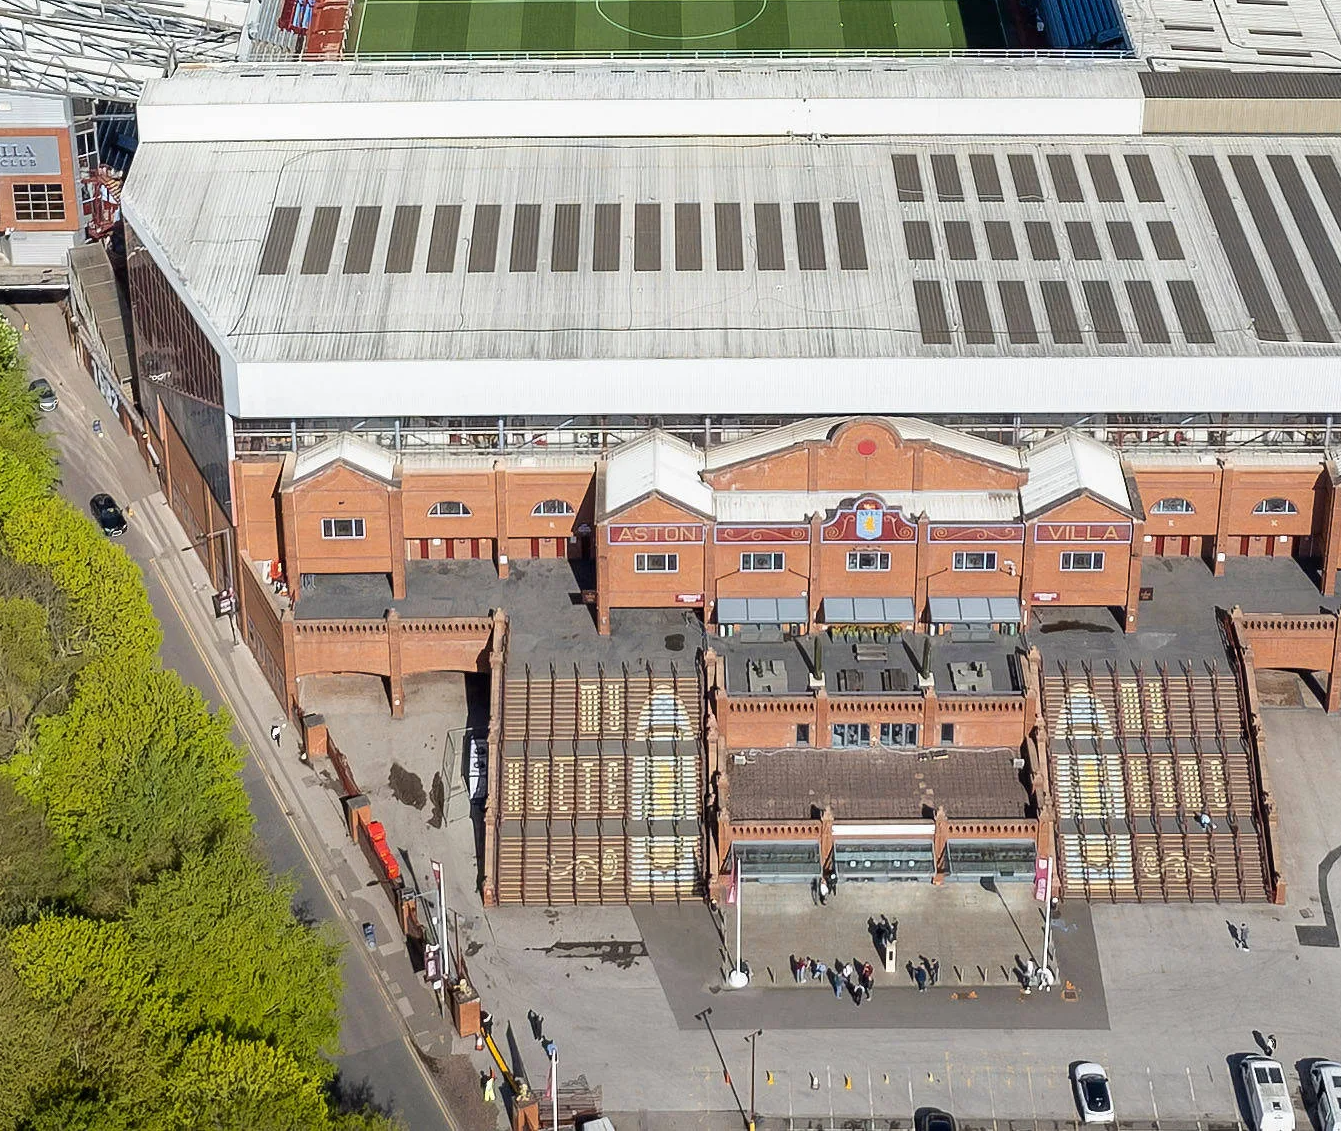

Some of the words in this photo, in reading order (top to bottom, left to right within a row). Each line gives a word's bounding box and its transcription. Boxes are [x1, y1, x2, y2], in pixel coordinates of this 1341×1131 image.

[0, 158, 37, 168] CLUB
[617, 526, 696, 541] ASTON
[1048, 525, 1120, 540] VILLA
[507, 760, 619, 811] HOLTE
[1128, 758, 1228, 809] HOME
